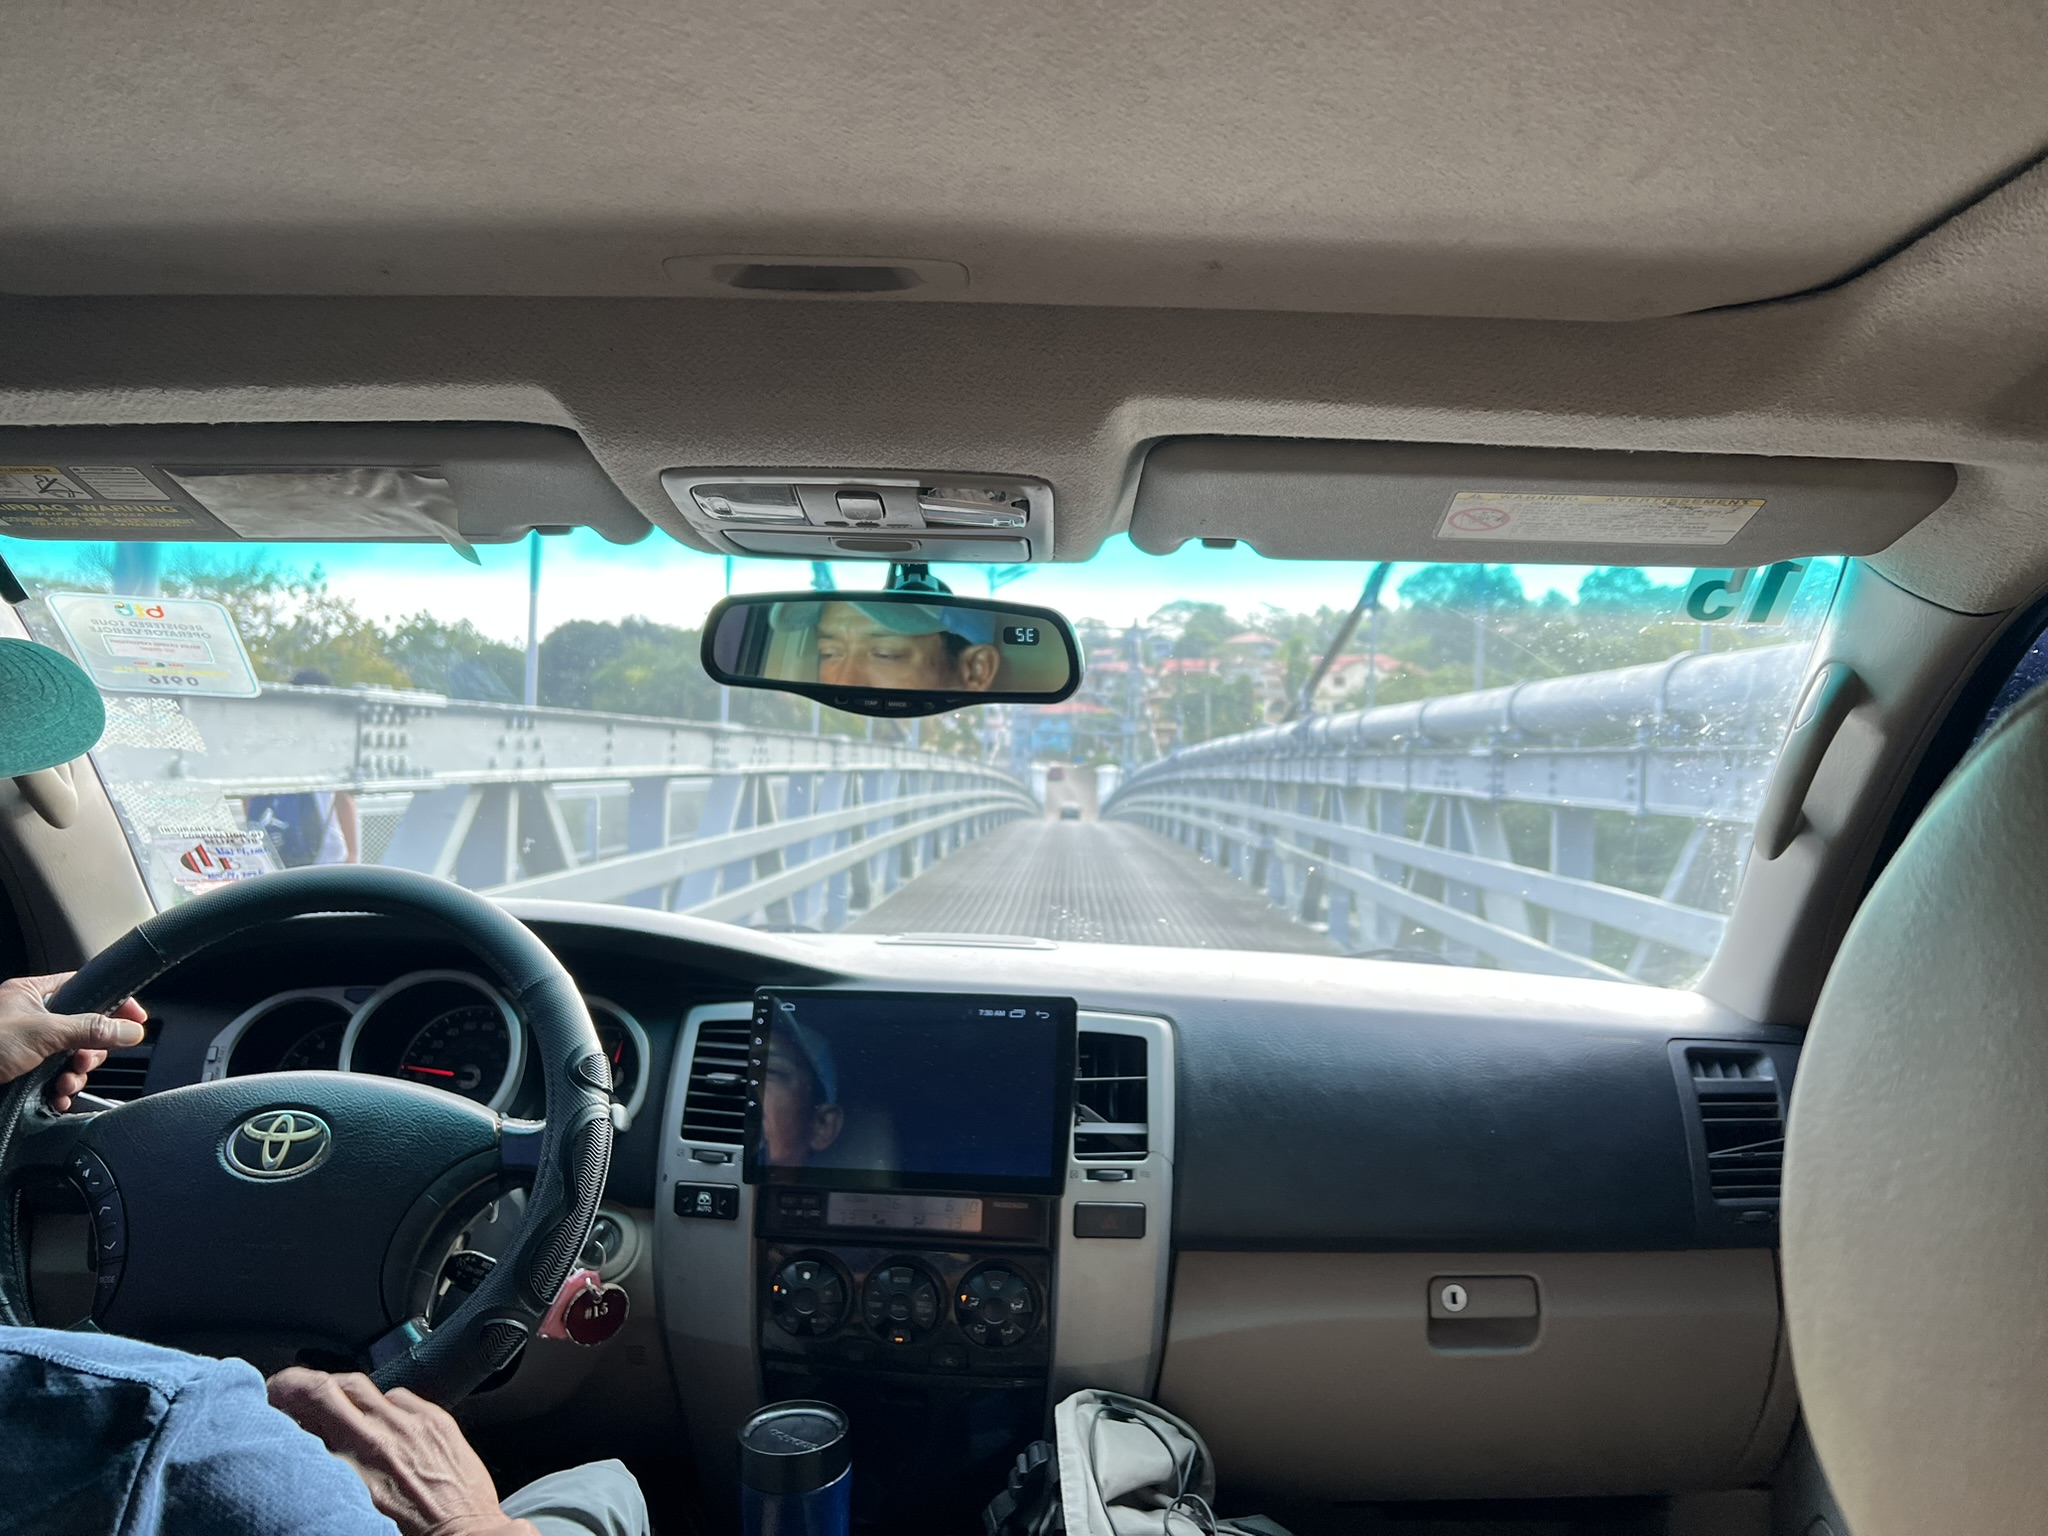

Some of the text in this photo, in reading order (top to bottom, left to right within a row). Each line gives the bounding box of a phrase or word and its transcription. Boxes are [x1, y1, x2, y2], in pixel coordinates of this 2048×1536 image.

[75, 504, 179, 513] WARNING
[1015, 628, 1035, 643] SE
[696, 1205, 713, 1213] AUTO
[584, 1302, 609, 1320] #15
